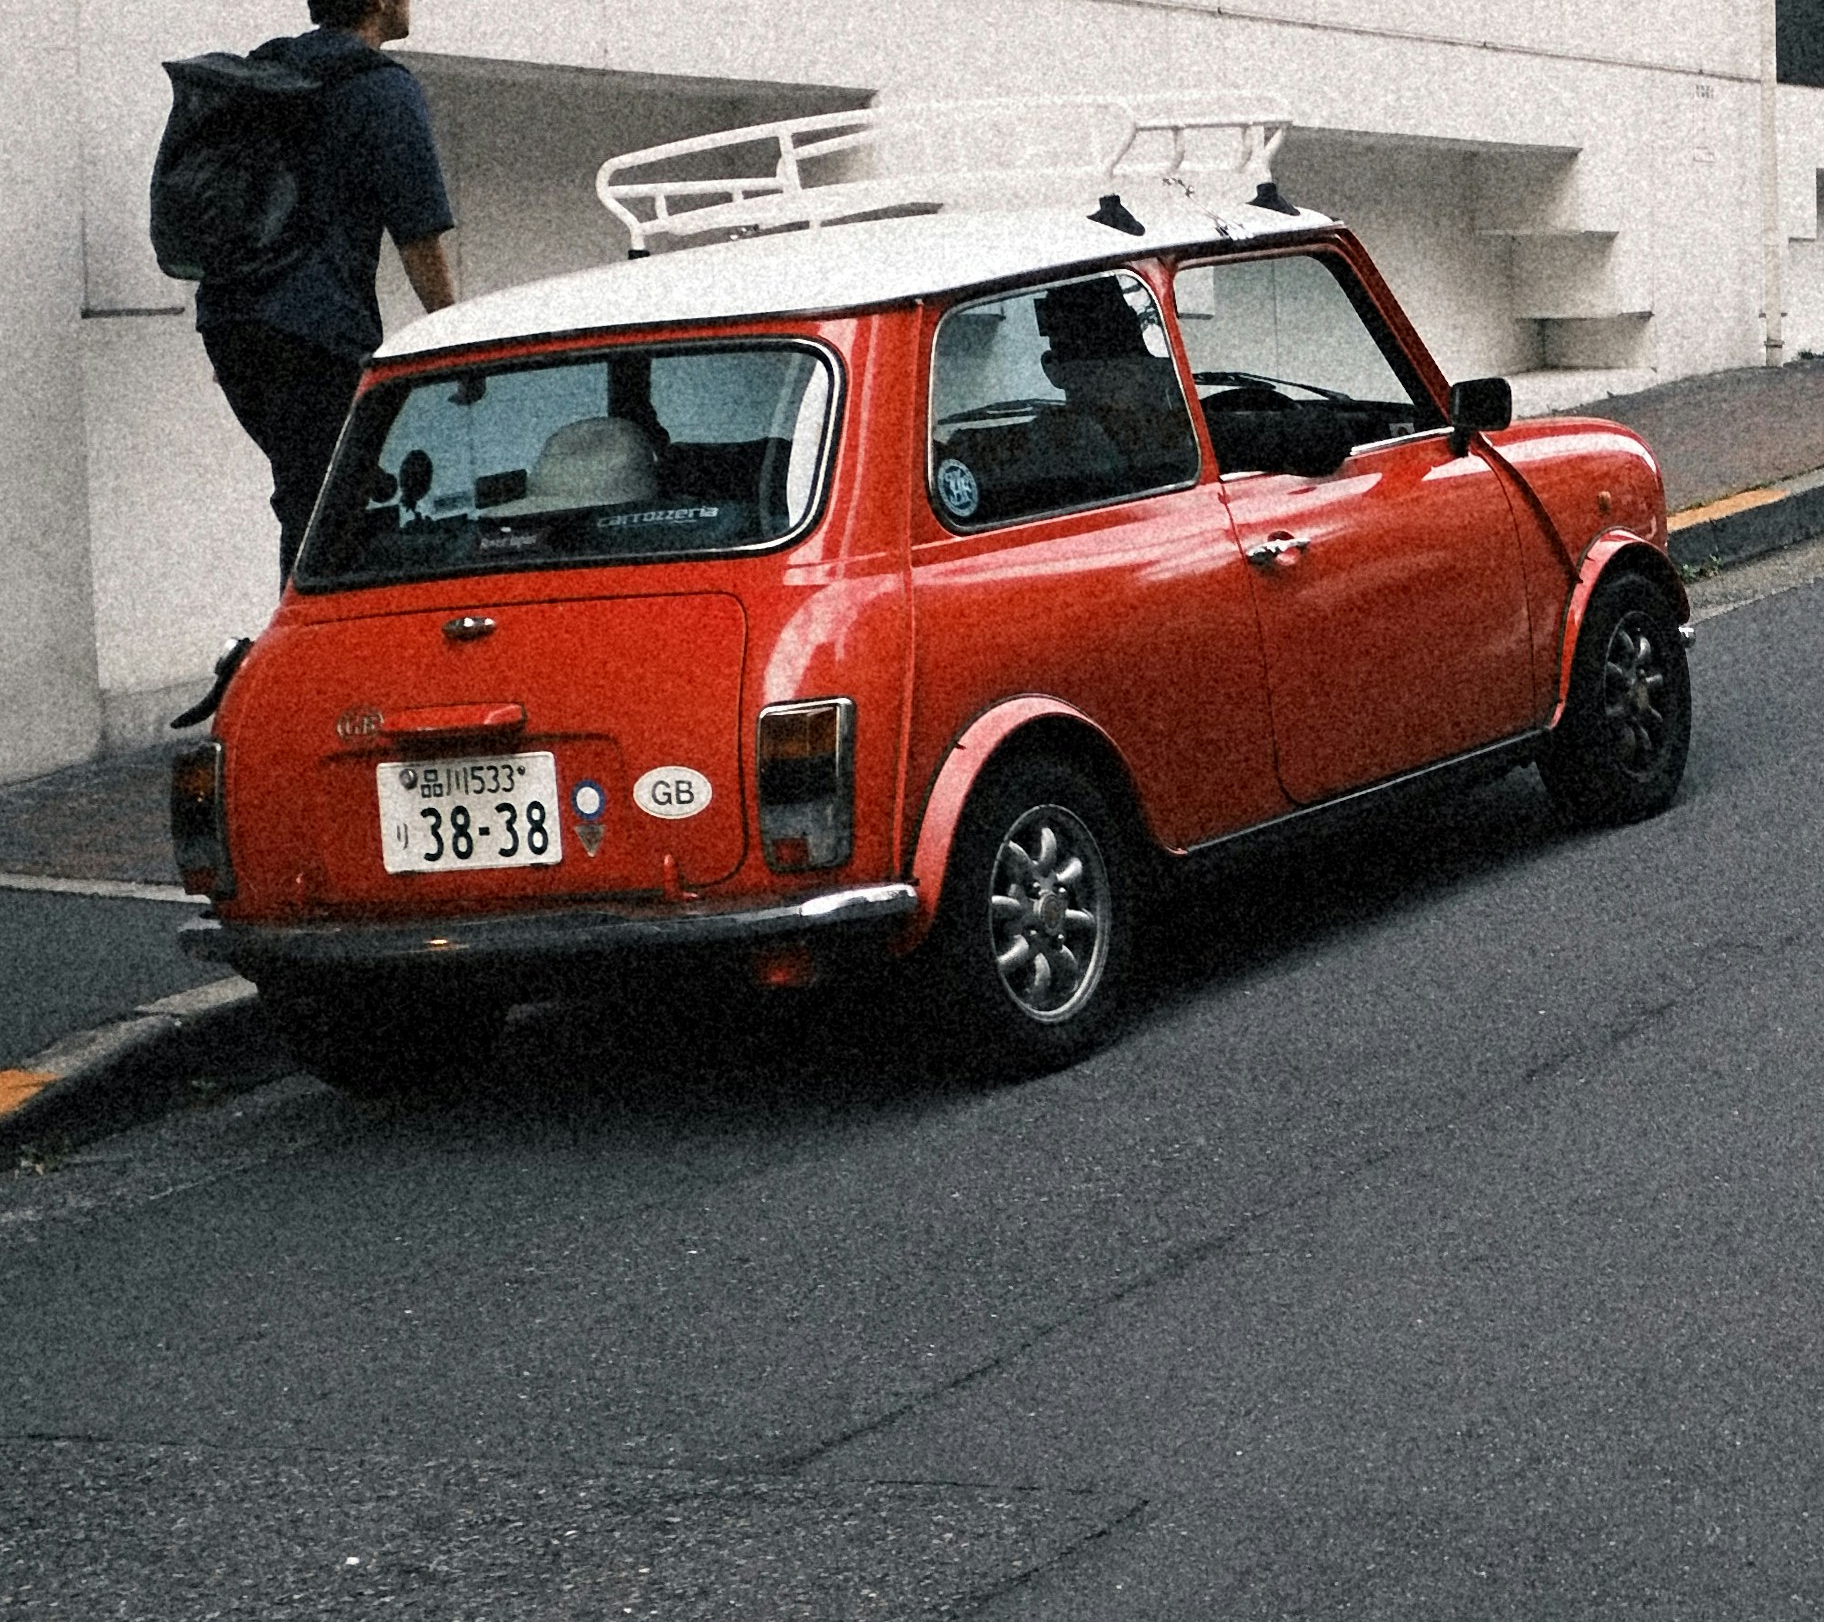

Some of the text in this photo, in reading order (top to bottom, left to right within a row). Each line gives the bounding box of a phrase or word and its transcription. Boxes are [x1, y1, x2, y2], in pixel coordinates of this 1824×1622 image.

[597, 505, 719, 528] carrozzeria
[650, 779, 696, 806] GB
[420, 800, 550, 862] 38-38
